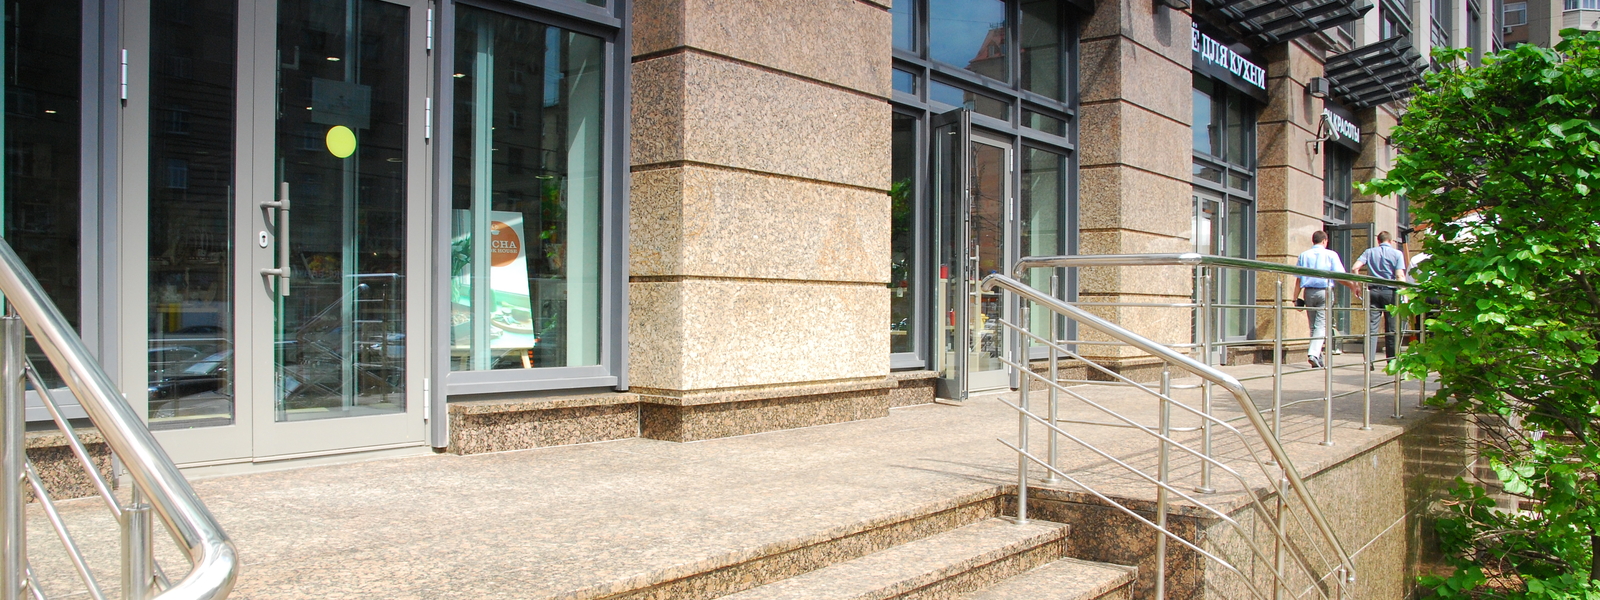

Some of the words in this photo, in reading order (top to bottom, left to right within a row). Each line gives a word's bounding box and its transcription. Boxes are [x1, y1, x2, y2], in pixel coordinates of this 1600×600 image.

[1191, 22, 1200, 53] Ё
[1201, 33, 1228, 68] ДЛЯ
[1229, 49, 1266, 90] КУХНИ
[1333, 113, 1360, 143] КРАСОТЫ
[491, 240, 517, 248] CHA
